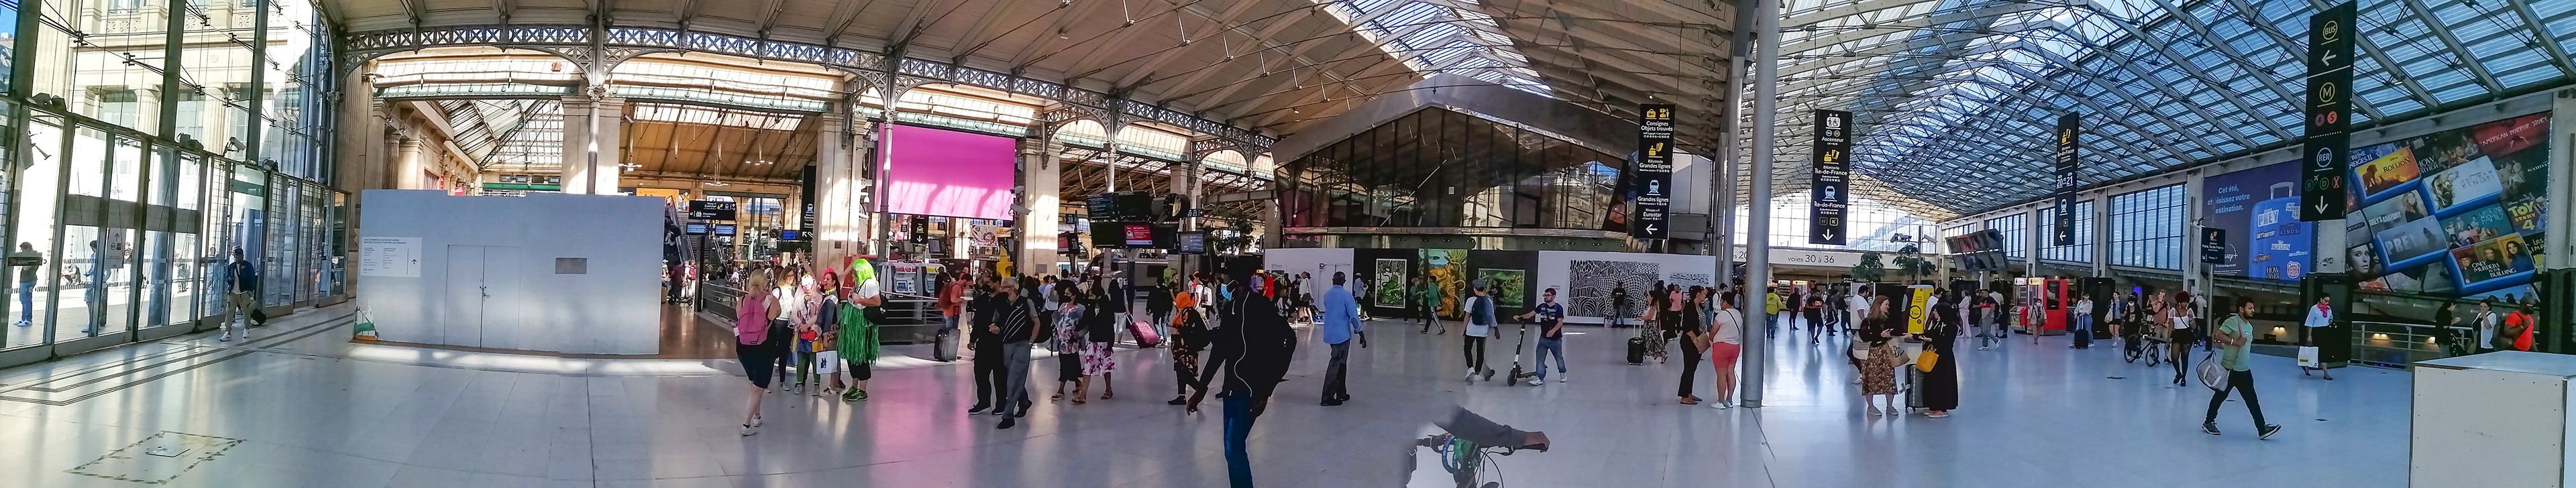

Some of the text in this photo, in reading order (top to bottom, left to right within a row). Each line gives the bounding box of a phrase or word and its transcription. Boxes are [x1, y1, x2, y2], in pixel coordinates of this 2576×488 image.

[2324, 25, 2336, 36] BUS
[2322, 86, 2332, 99] M
[2483, 116, 2547, 146] AMERICAN HORROR STORY
[2318, 153, 2330, 162] RER
[2351, 150, 2367, 161] REINE
[2349, 157, 2367, 168] NEIGES
[2383, 157, 2411, 173] ROI LION
[1815, 167, 1847, 176] Île-de-France
[2057, 178, 2063, 187] 20
[2067, 176, 2073, 185] 21
[2462, 174, 2495, 189] KENOBI
[2228, 184, 2239, 192] été,
[1813, 200, 1845, 208] Île-de-France
[2215, 204, 2244, 214] estination.
[2508, 201, 2534, 217] TOY
[2259, 210, 2279, 227] PREY
[2368, 211, 2401, 227] GREY'S ANATOMY
[2481, 212, 2504, 225] FAMILY
[2515, 212, 2536, 222] STORY
[2522, 220, 2535, 231] 4
[2385, 234, 2418, 255] PREY
[2532, 237, 2544, 246] Les
[1805, 254, 1816, 263] 30
[1823, 255, 1835, 263] 36
[2471, 260, 2486, 268] ONLY
[2473, 262, 2500, 273] MURDERS
[2489, 267, 2517, 278] BUILDING
